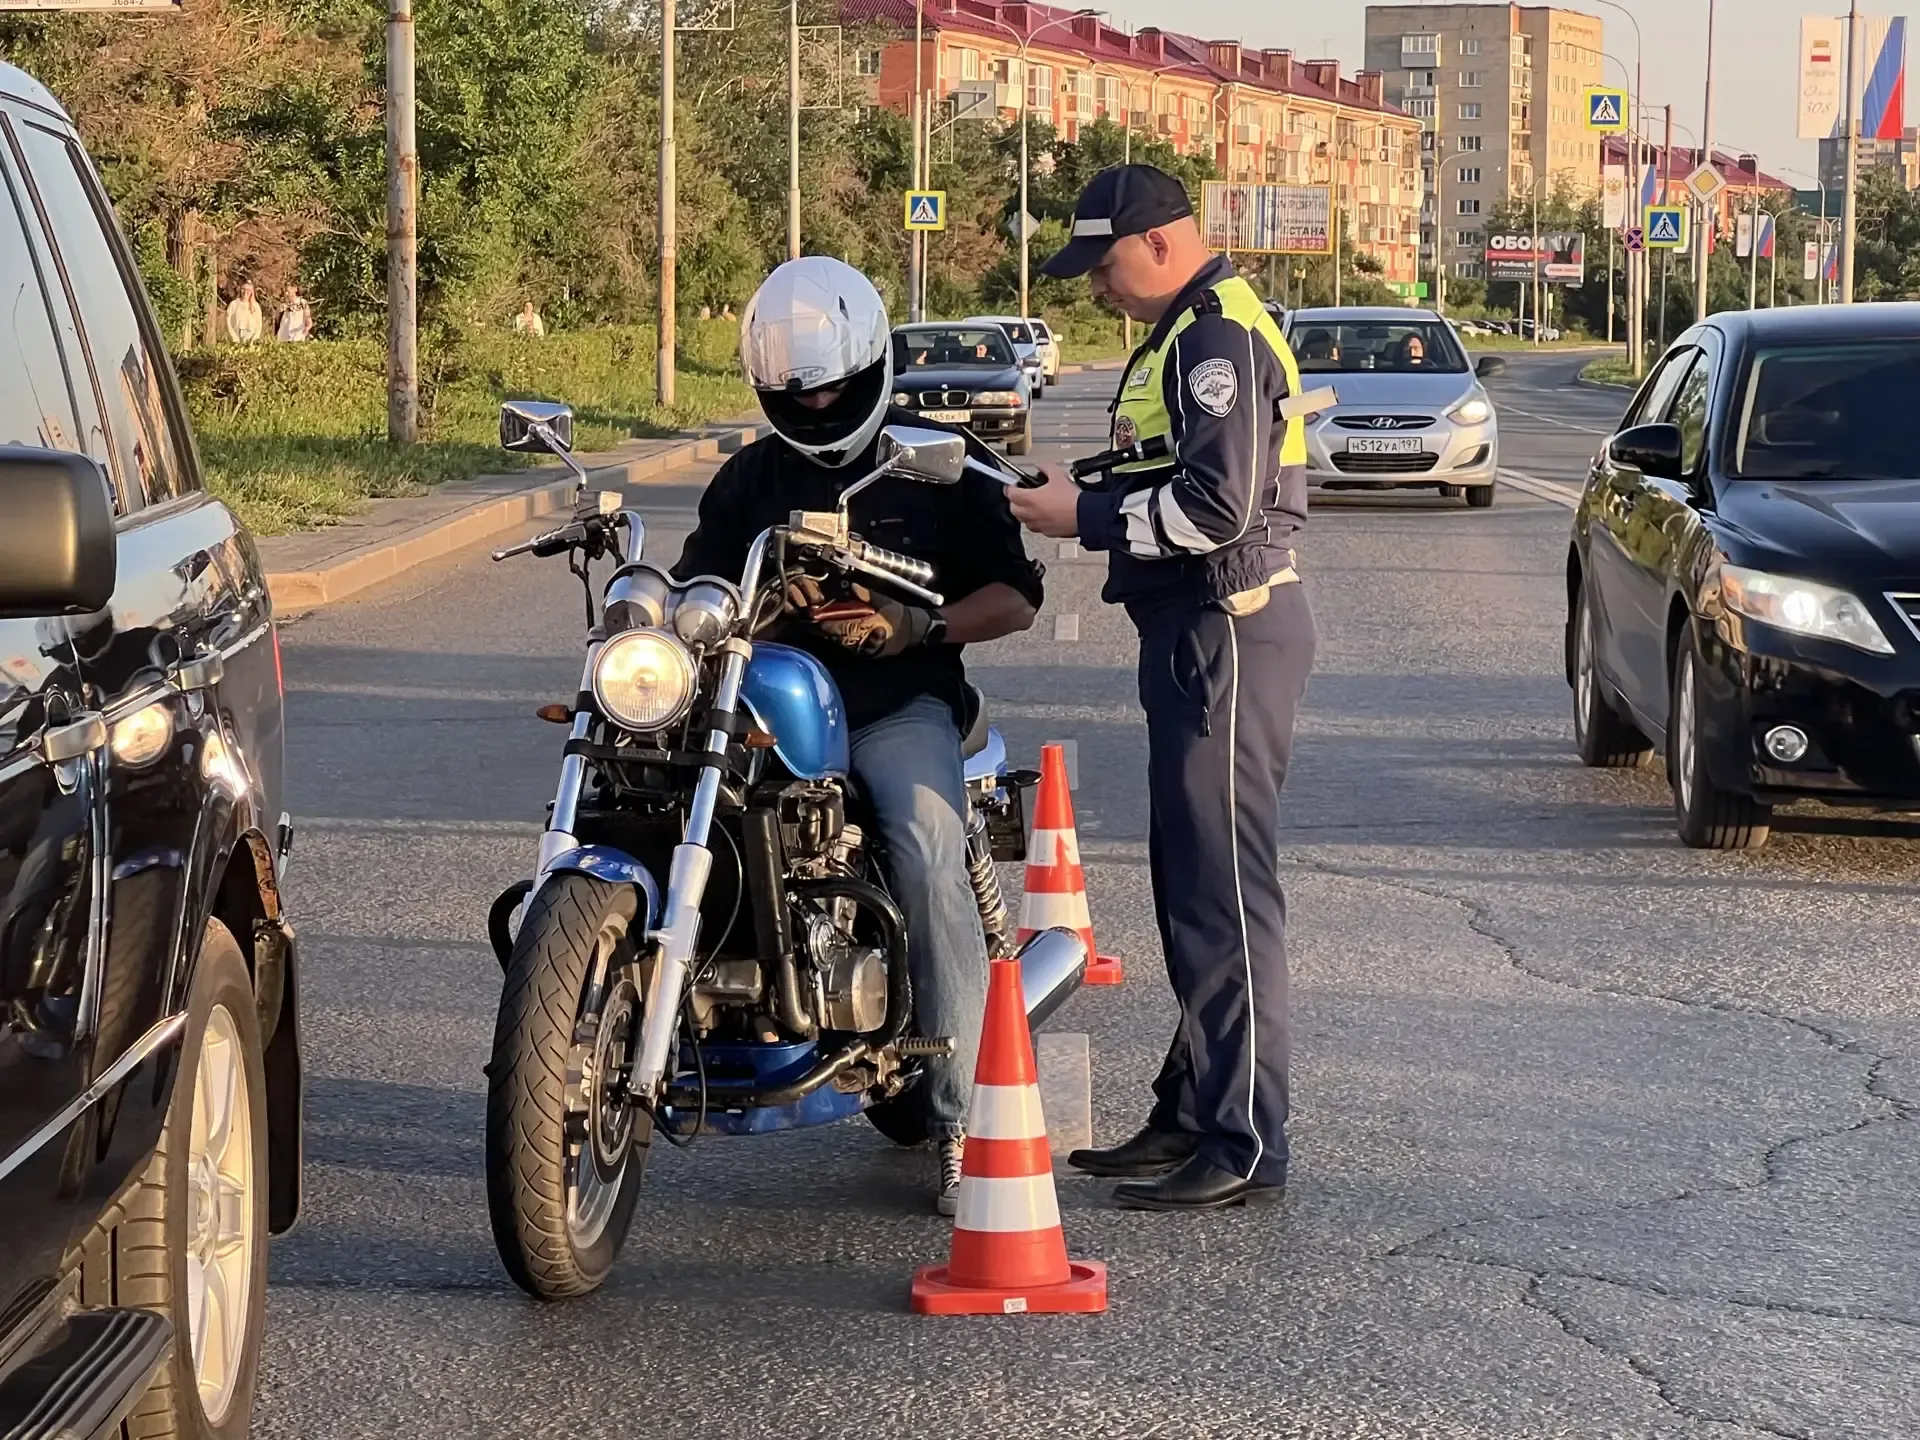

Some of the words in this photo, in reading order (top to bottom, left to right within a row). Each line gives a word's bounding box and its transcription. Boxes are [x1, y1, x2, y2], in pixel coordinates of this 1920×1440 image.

[1490, 235, 1546, 250] ОБОИ
[1197, 370, 1230, 388] РОССИЯ
[1352, 440, 1398, 452] Н512УА
[1400, 440, 1417, 449] 197
